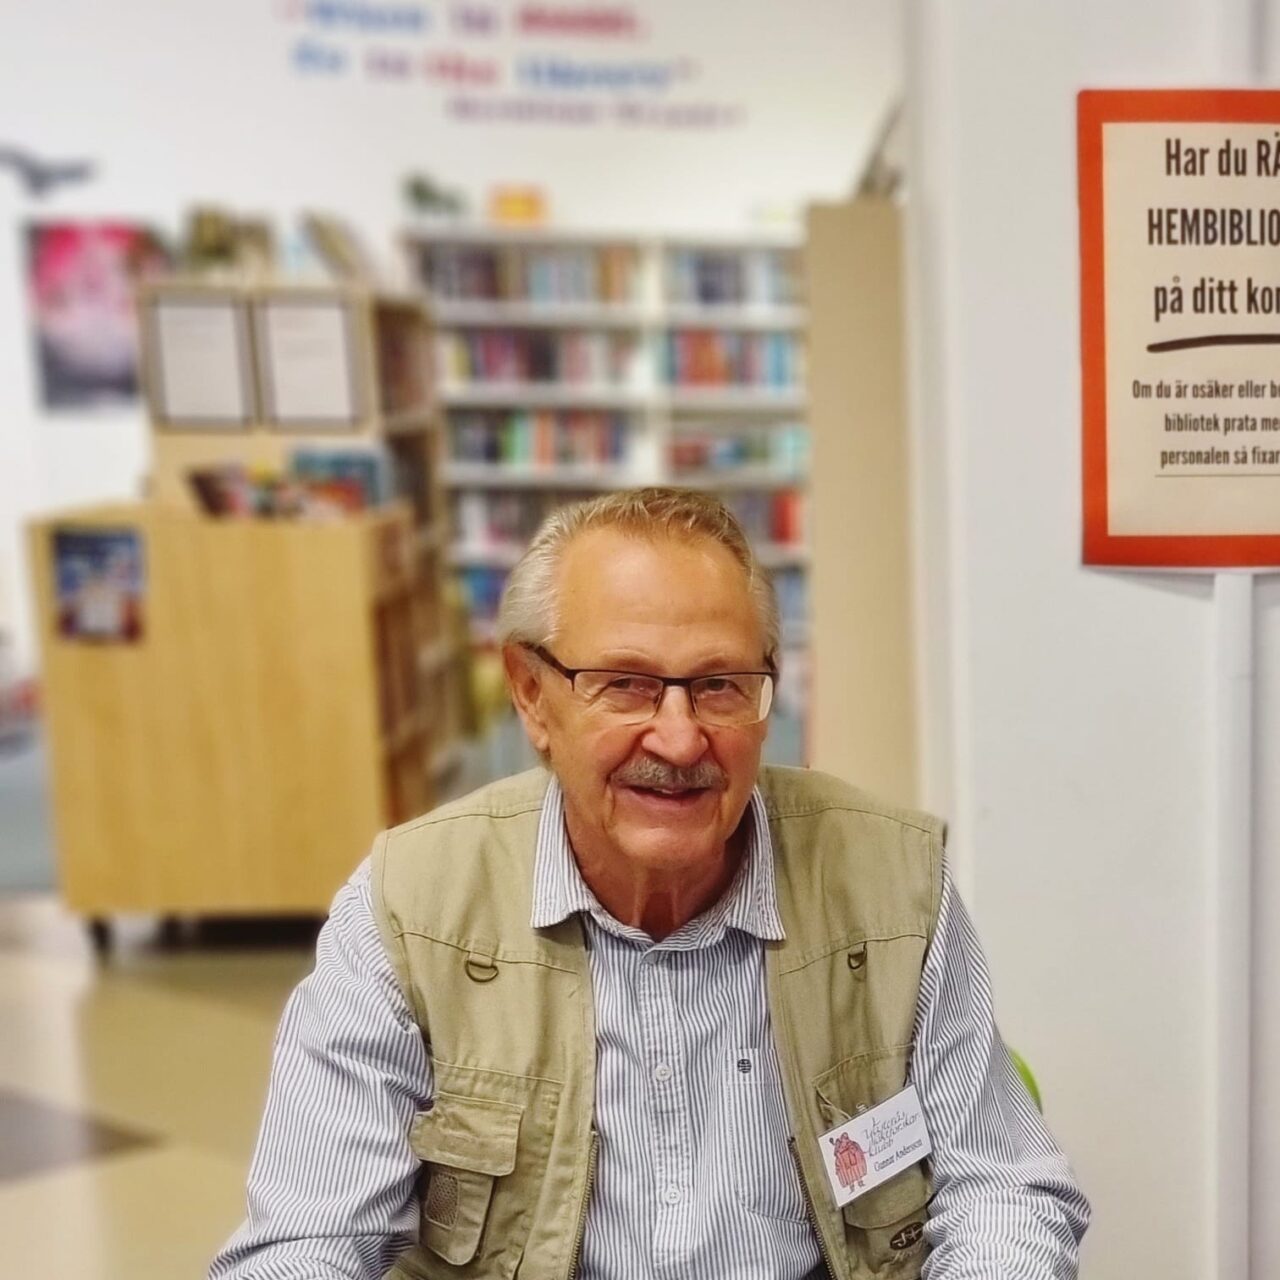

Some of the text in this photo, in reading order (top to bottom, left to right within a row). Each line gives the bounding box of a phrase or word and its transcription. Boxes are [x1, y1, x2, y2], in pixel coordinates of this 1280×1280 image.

[1165, 137, 1211, 177] Har
[1217, 138, 1248, 177] du
[1153, 275, 1184, 324] på
[1192, 276, 1239, 315] ditt
[1132, 379, 1152, 399] Om
[1155, 380, 1172, 399] du
[1174, 379, 1189, 399] är
[1191, 379, 1235, 399] osäker
[1237, 379, 1267, 399] eller
[1164, 413, 1221, 433] bibliotek
[1223, 414, 1258, 437] prata
[1160, 446, 1230, 470] personalen
[1233, 446, 1248, 465] så
[1251, 445, 1280, 465] fixar
